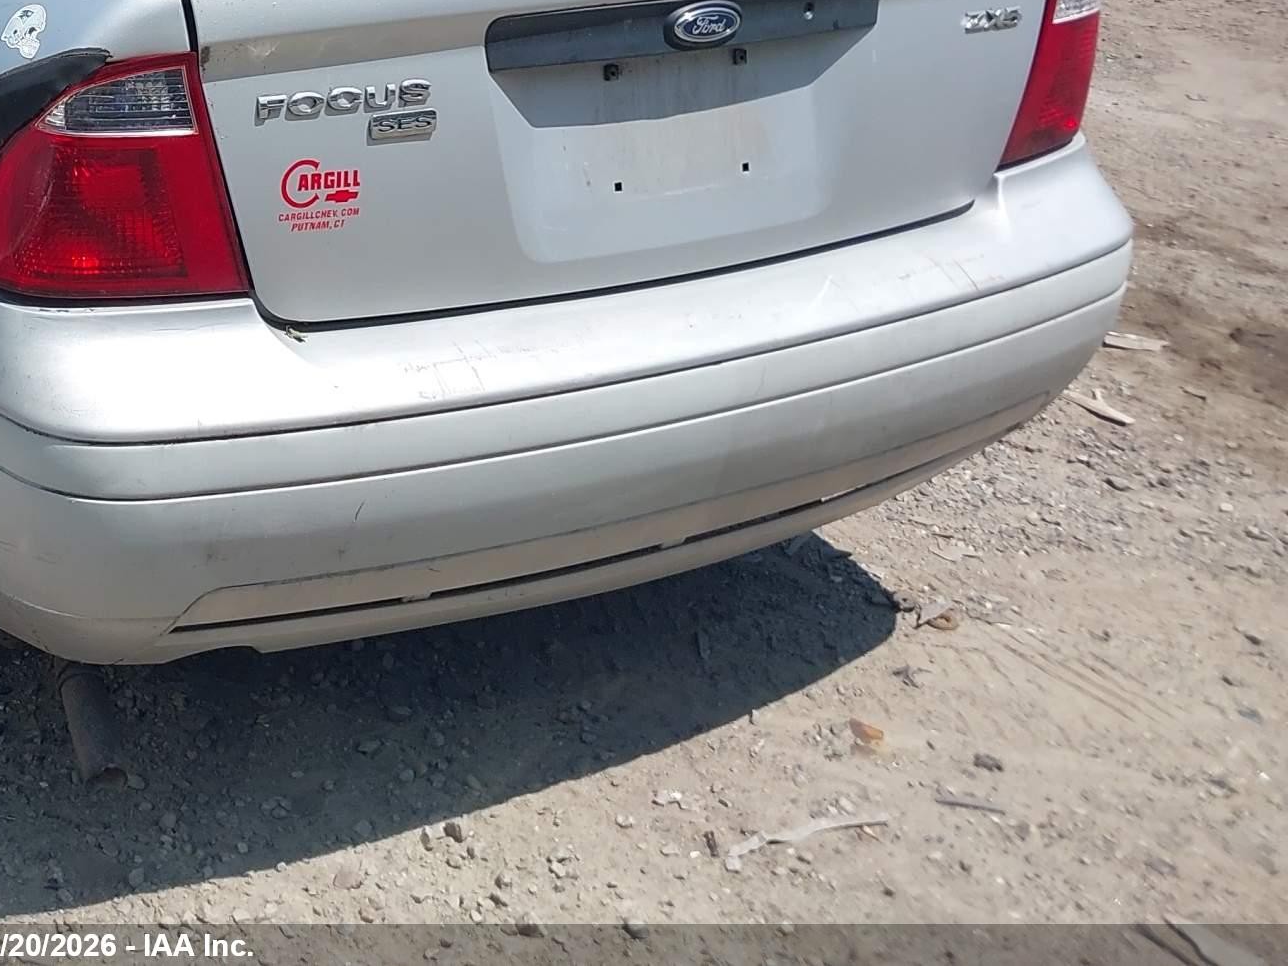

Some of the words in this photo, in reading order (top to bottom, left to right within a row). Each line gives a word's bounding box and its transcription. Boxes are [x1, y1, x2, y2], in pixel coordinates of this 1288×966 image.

[692, 15, 727, 35] Ford
[255, 78, 432, 124] FOCUS
[375, 114, 433, 136] SES
[281, 159, 361, 208] CARGILL
